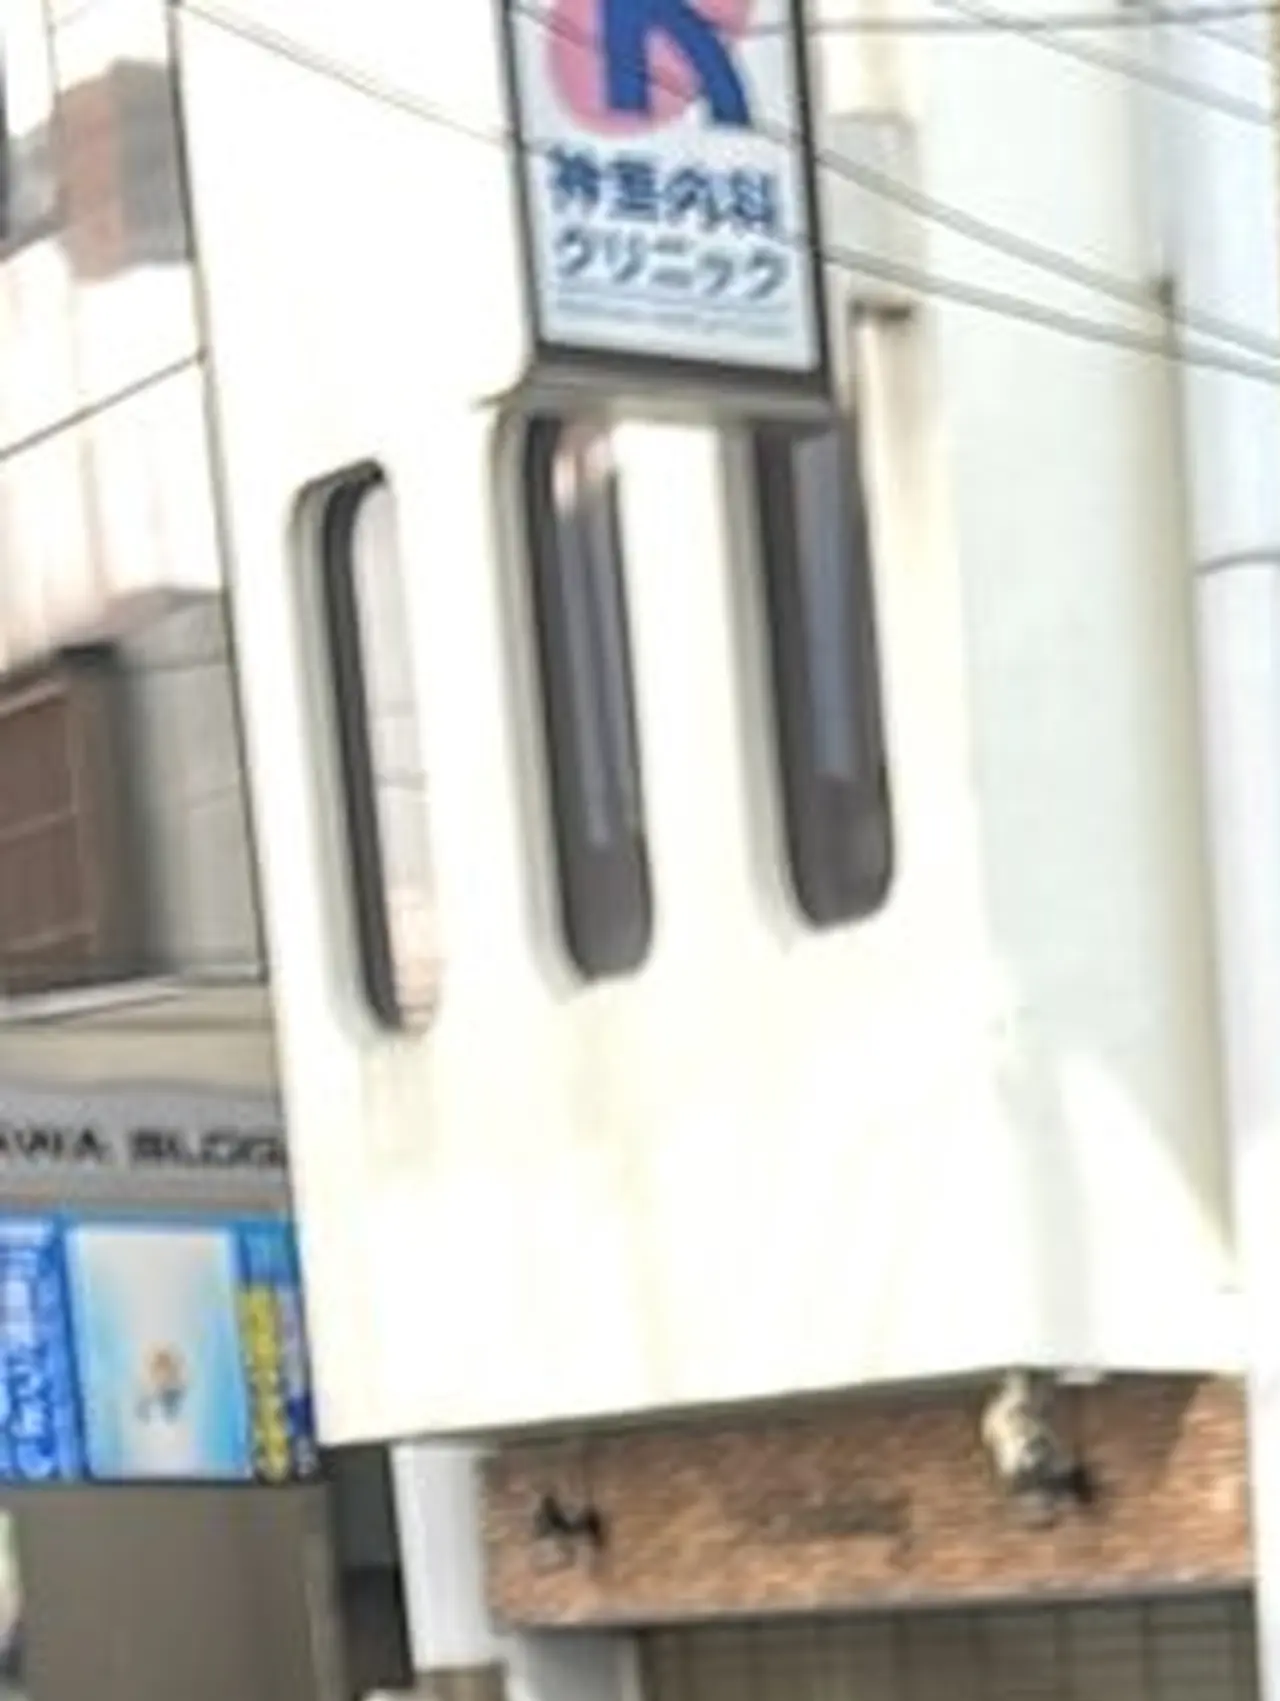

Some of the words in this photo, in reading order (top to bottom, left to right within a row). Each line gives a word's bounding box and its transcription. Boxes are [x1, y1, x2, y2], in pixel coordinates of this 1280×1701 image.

[554, 226, 792, 299] クリニック
[0, 1127, 110, 1162] WA
